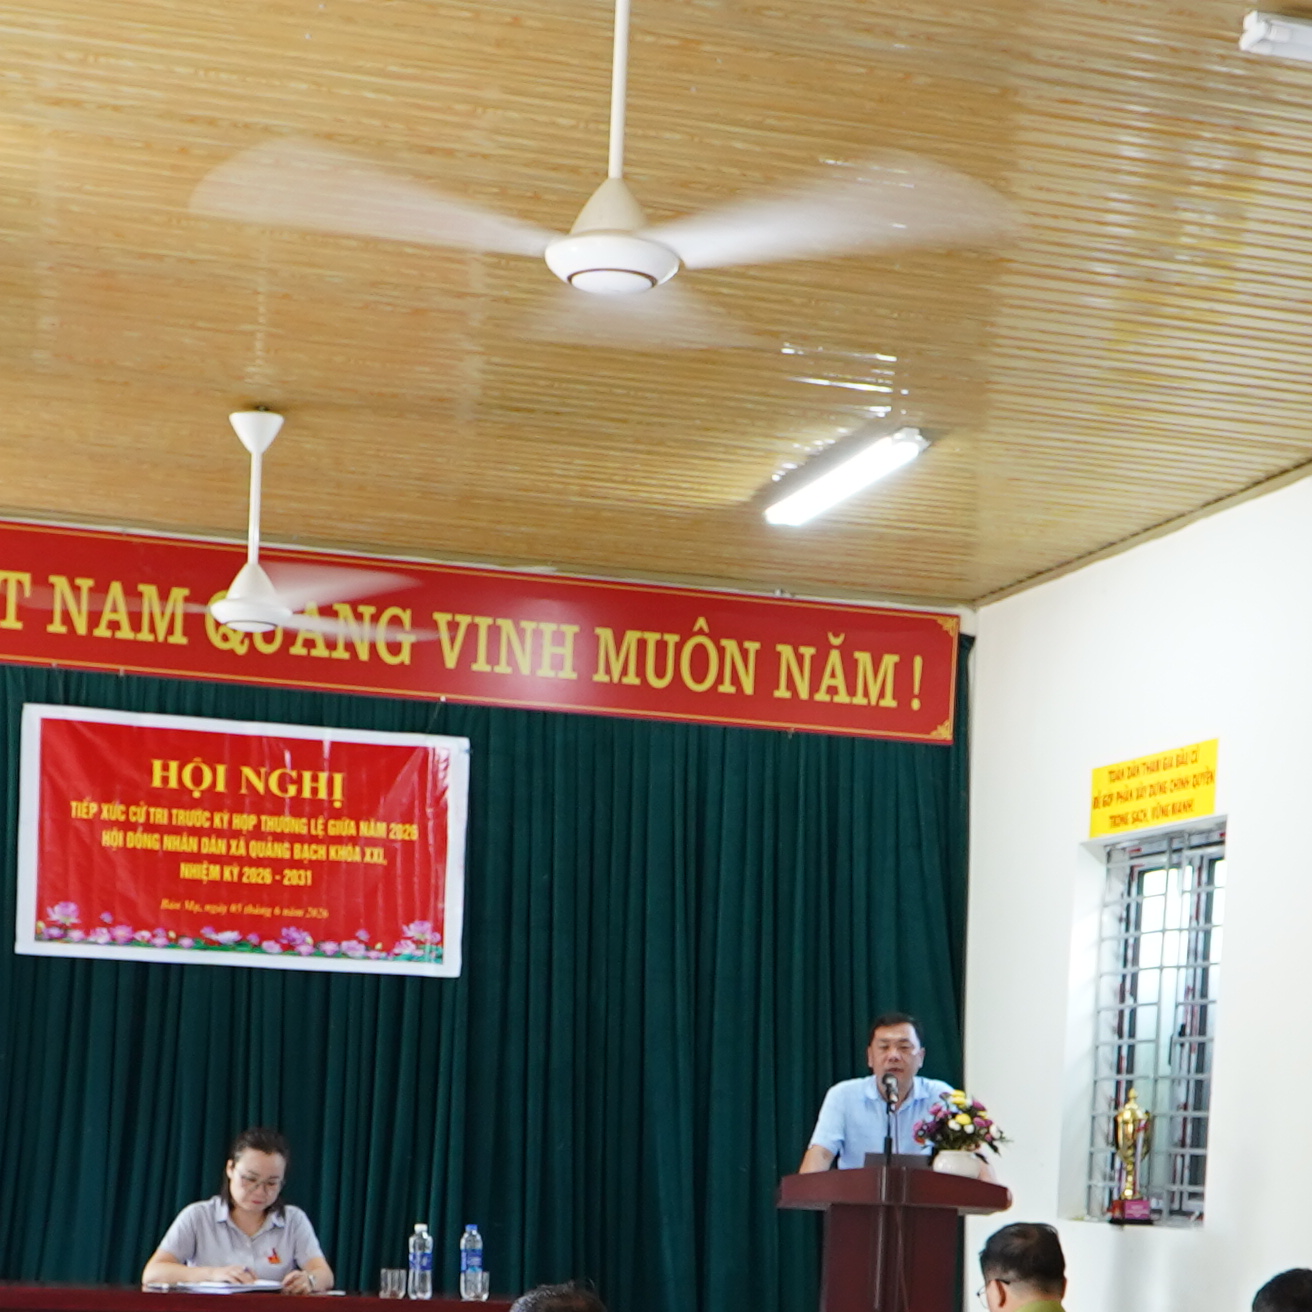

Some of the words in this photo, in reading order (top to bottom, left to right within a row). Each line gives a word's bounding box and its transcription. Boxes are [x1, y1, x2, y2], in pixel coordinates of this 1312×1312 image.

[46, 574, 190, 645] NAM
[432, 611, 578, 681] VINH
[593, 617, 761, 695] MUÔN
[773, 631, 900, 708] NĂM
[151, 757, 227, 798] HỘI
[239, 765, 345, 808] NGHỊ
[70, 796, 99, 819] TIẾP
[100, 799, 126, 822] XÚC
[148, 806, 169, 825] TRI
[389, 823, 419, 841] 2026
[101, 826, 124, 851] HỘI
[163, 832, 199, 853] NHÂN
[201, 834, 227, 855] DÂN
[180, 860, 221, 884] NHIỆM
[242, 867, 272, 885] 2026
[283, 868, 312, 886] 2031
